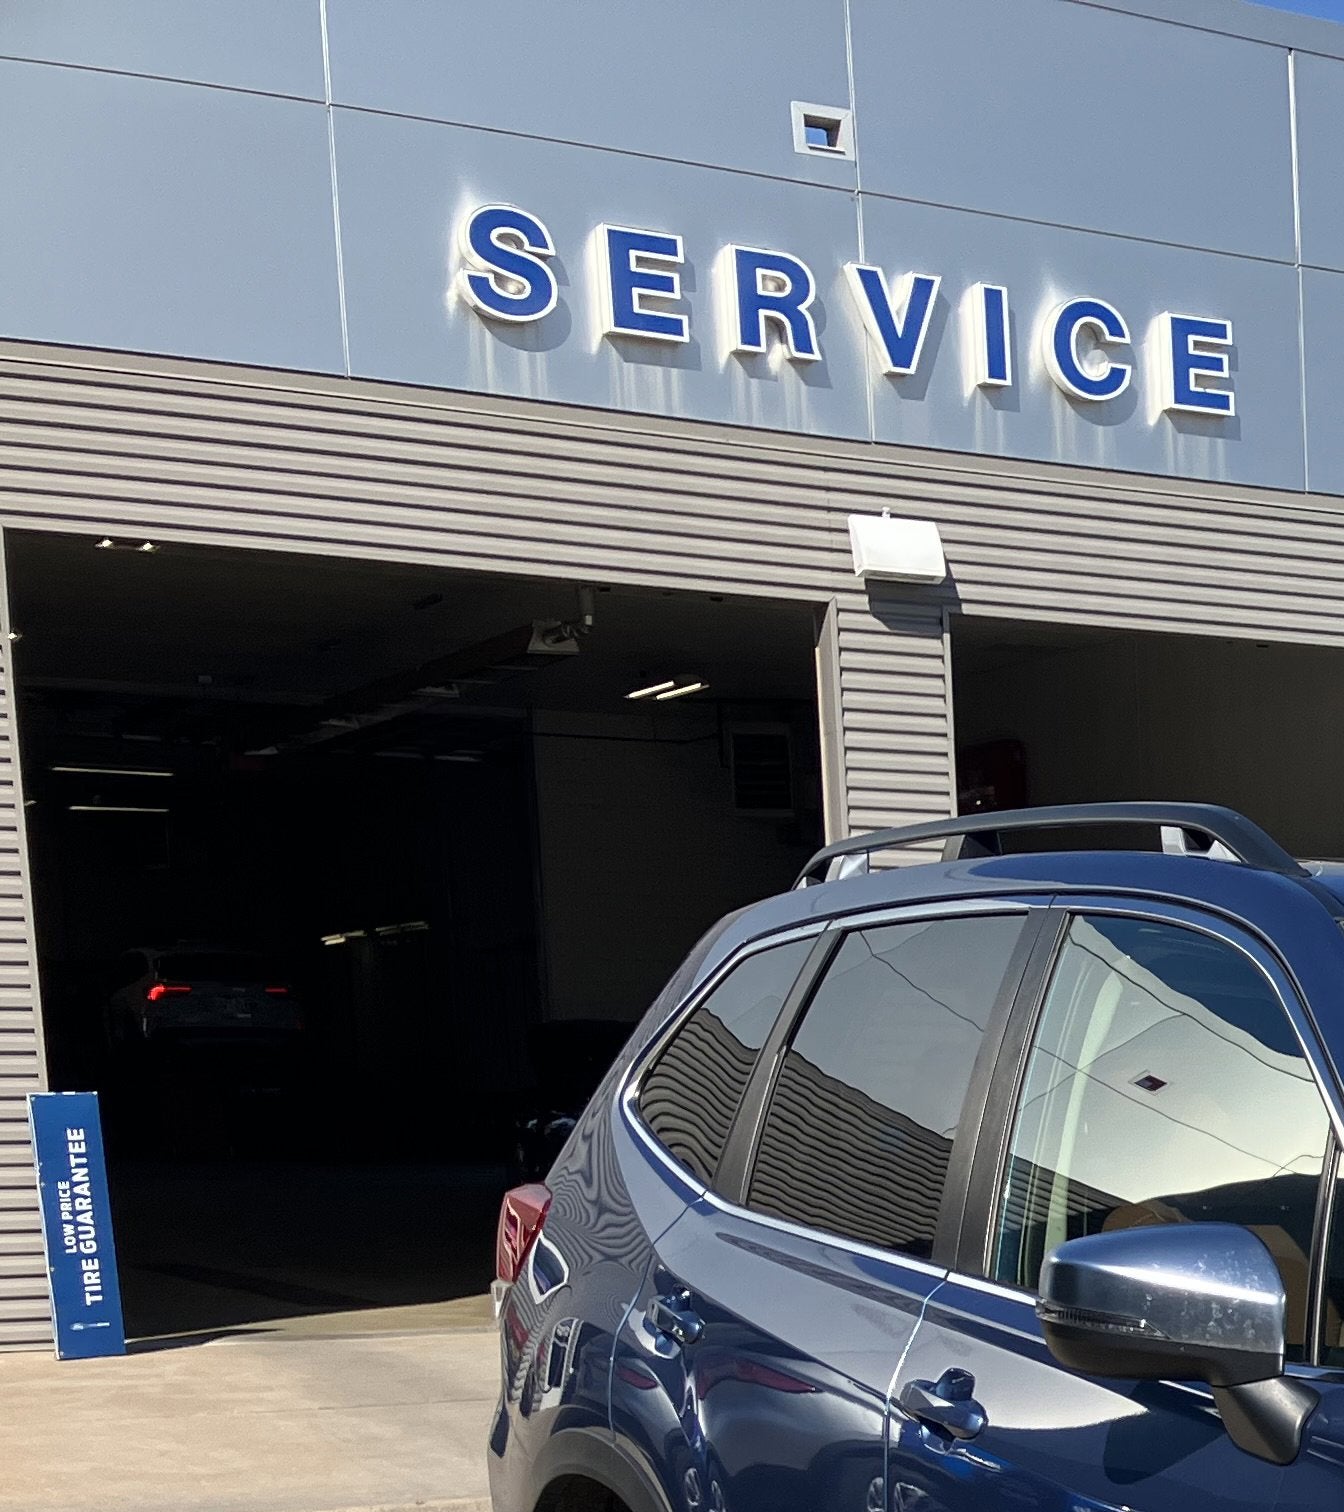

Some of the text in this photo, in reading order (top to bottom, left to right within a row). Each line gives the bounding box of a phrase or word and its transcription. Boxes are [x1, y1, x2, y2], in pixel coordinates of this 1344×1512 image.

[457, 203, 1236, 417] SERVICE
[58, 1181, 77, 1254] LOW PRICE
[66, 1128, 103, 1307] TIRE GUARANTEE
